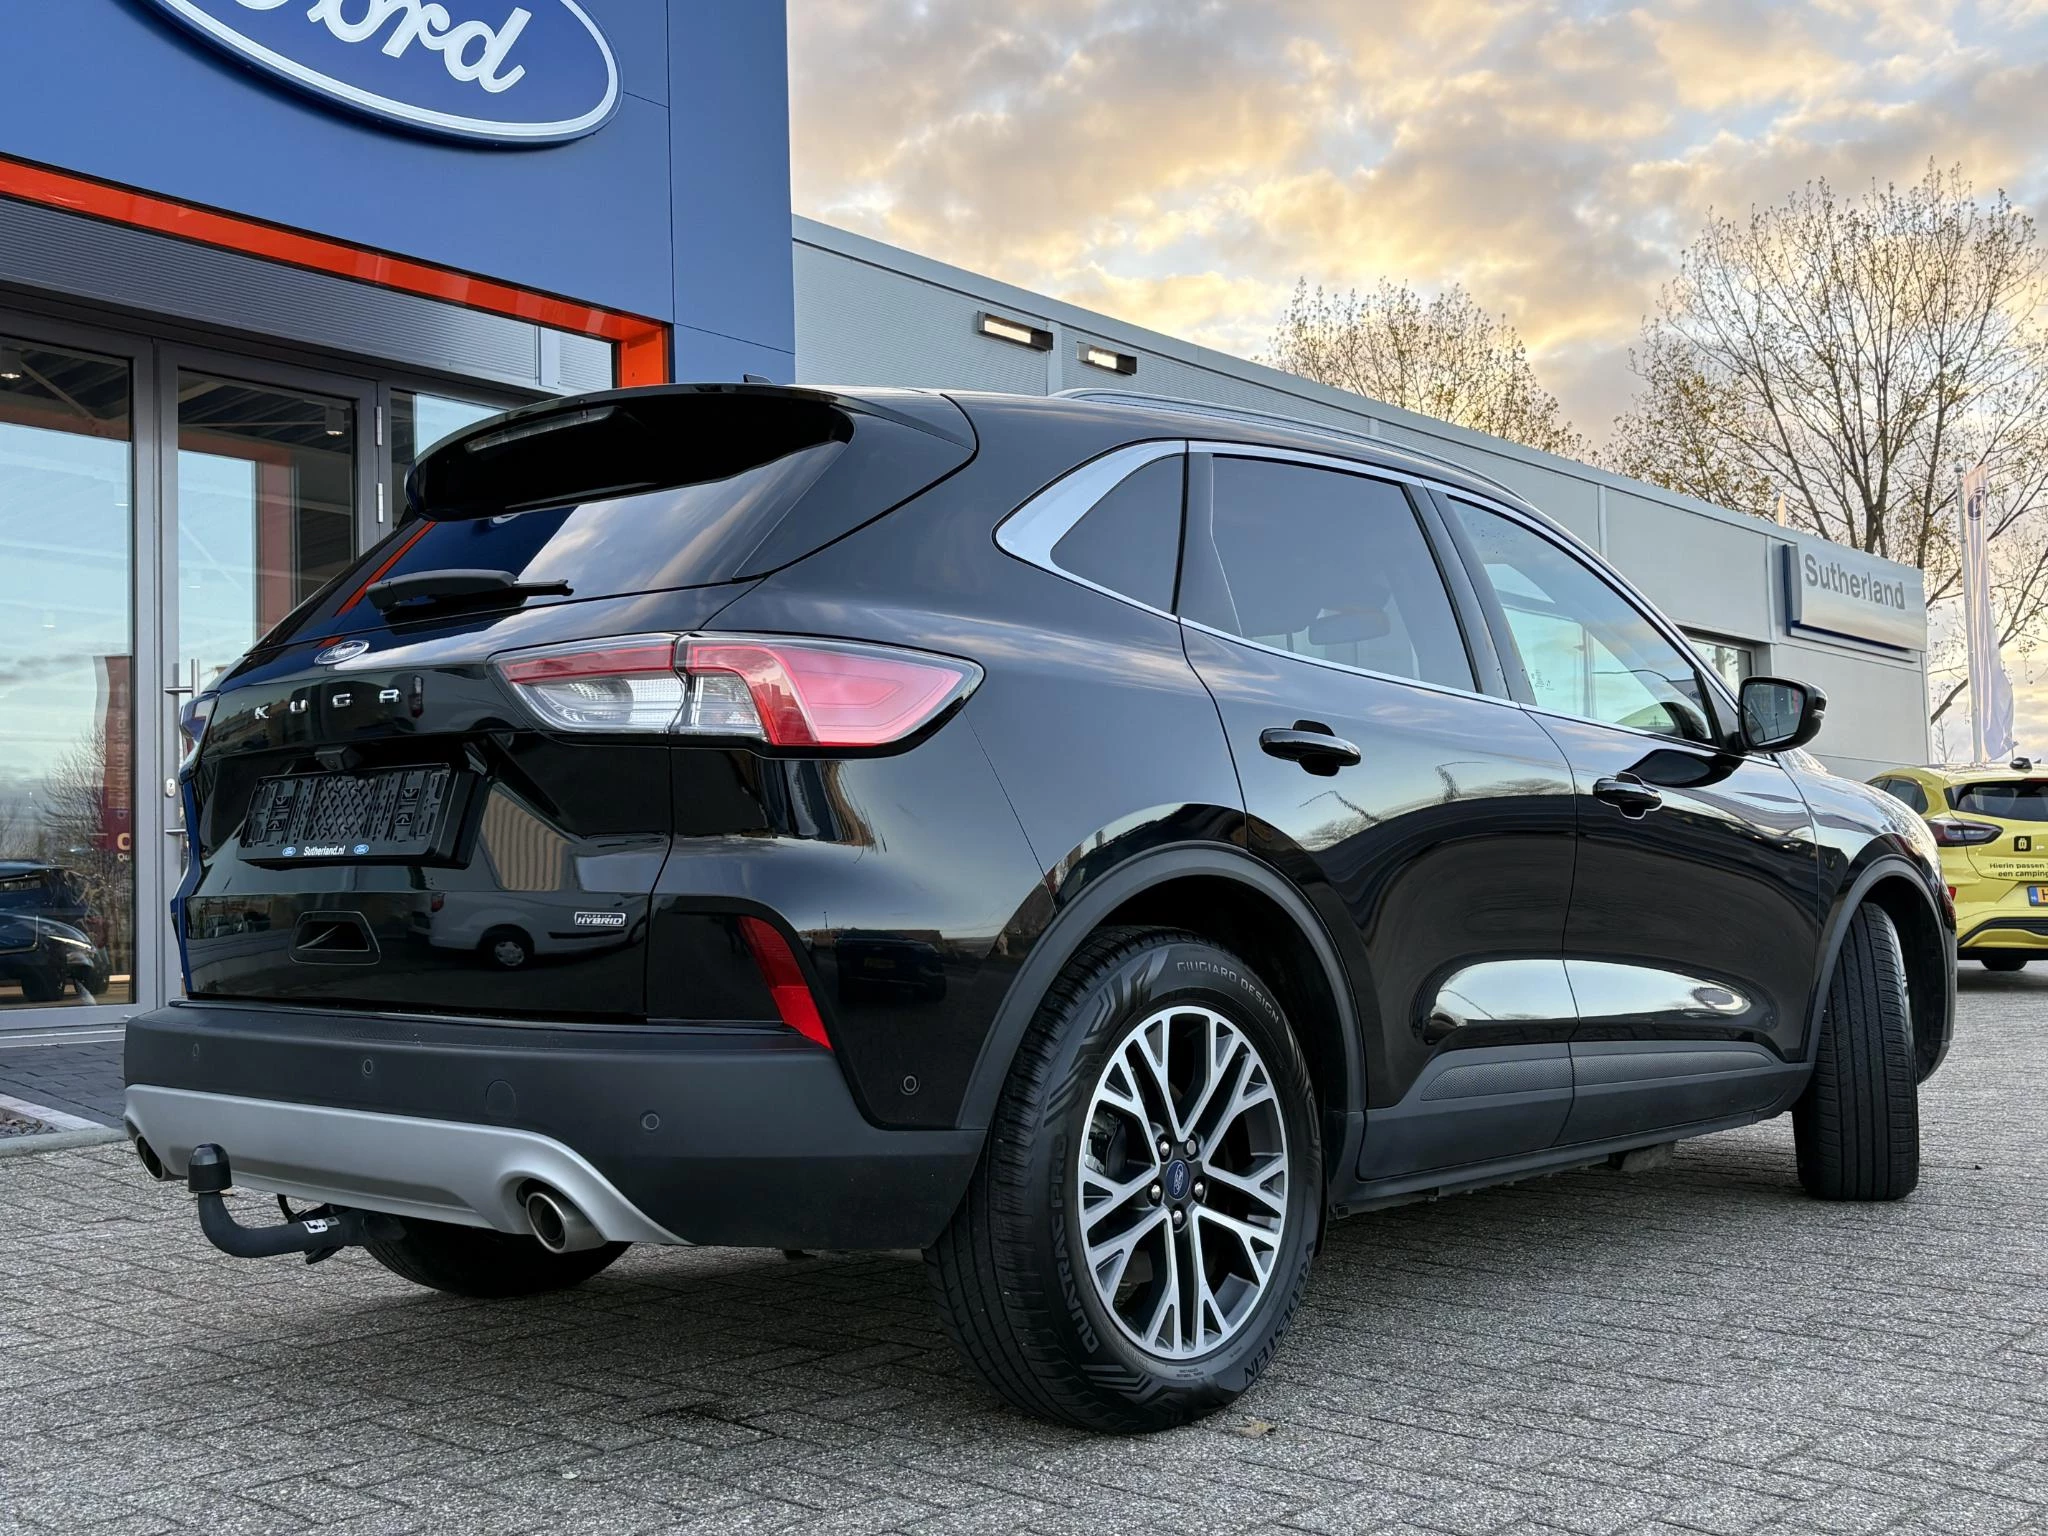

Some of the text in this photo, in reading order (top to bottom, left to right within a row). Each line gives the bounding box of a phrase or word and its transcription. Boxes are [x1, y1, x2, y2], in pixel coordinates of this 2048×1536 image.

[233, 0, 532, 93] ord
[1804, 553, 1906, 610] Sutherland
[254, 688, 402, 720] KUGA
[303, 845, 346, 856] Sutherland.nl
[577, 917, 623, 925] HYBRID
[1177, 961, 1279, 1024] GIUGIARO DESIGN
[1051, 1214, 1100, 1355] QUATRAC
